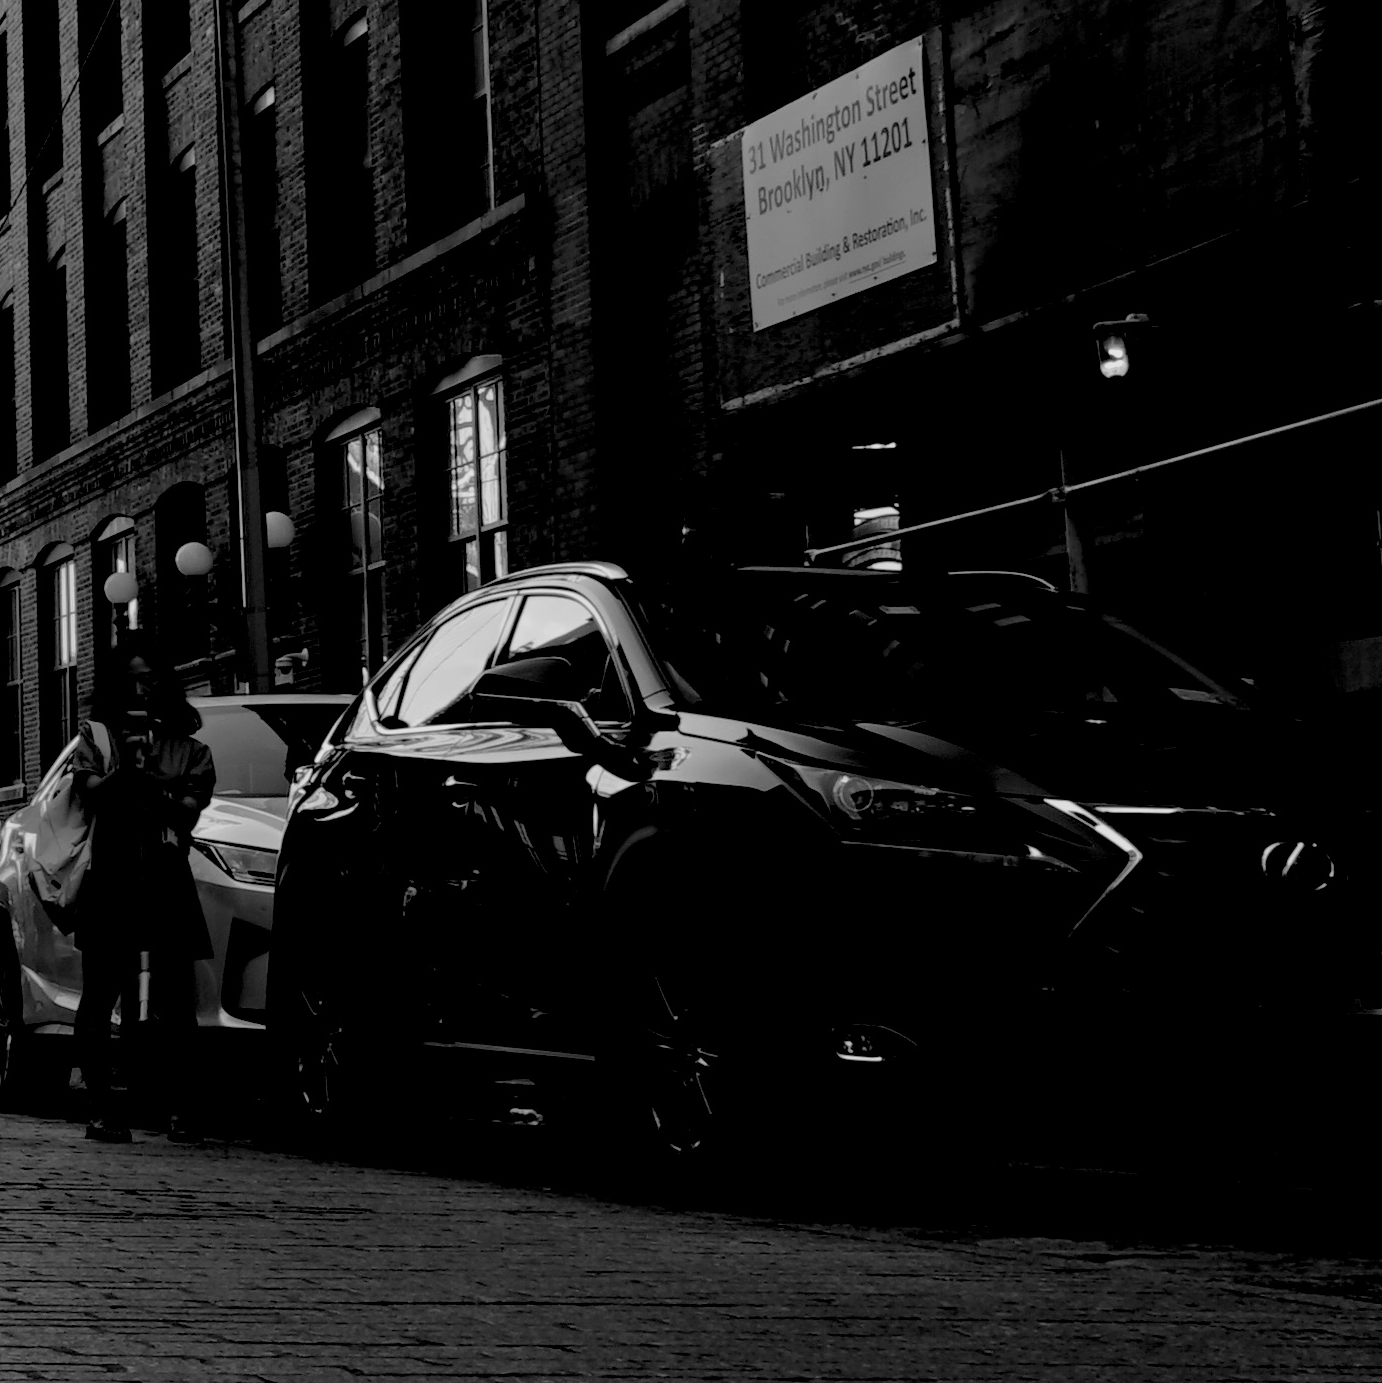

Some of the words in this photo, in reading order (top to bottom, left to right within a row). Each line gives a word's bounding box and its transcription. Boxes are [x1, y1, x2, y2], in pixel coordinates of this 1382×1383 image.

[748, 141, 766, 175] 31
[769, 99, 861, 163] Washington
[866, 67, 917, 117] Street
[759, 165, 830, 215] Brooklyn,
[834, 141, 856, 180] NY
[861, 117, 913, 167] 11201
[756, 254, 804, 289] Commercial
[805, 243, 841, 270] Building
[843, 235, 851, 253] &
[852, 217, 909, 249] Restoration,
[910, 208, 927, 226] Inc.
